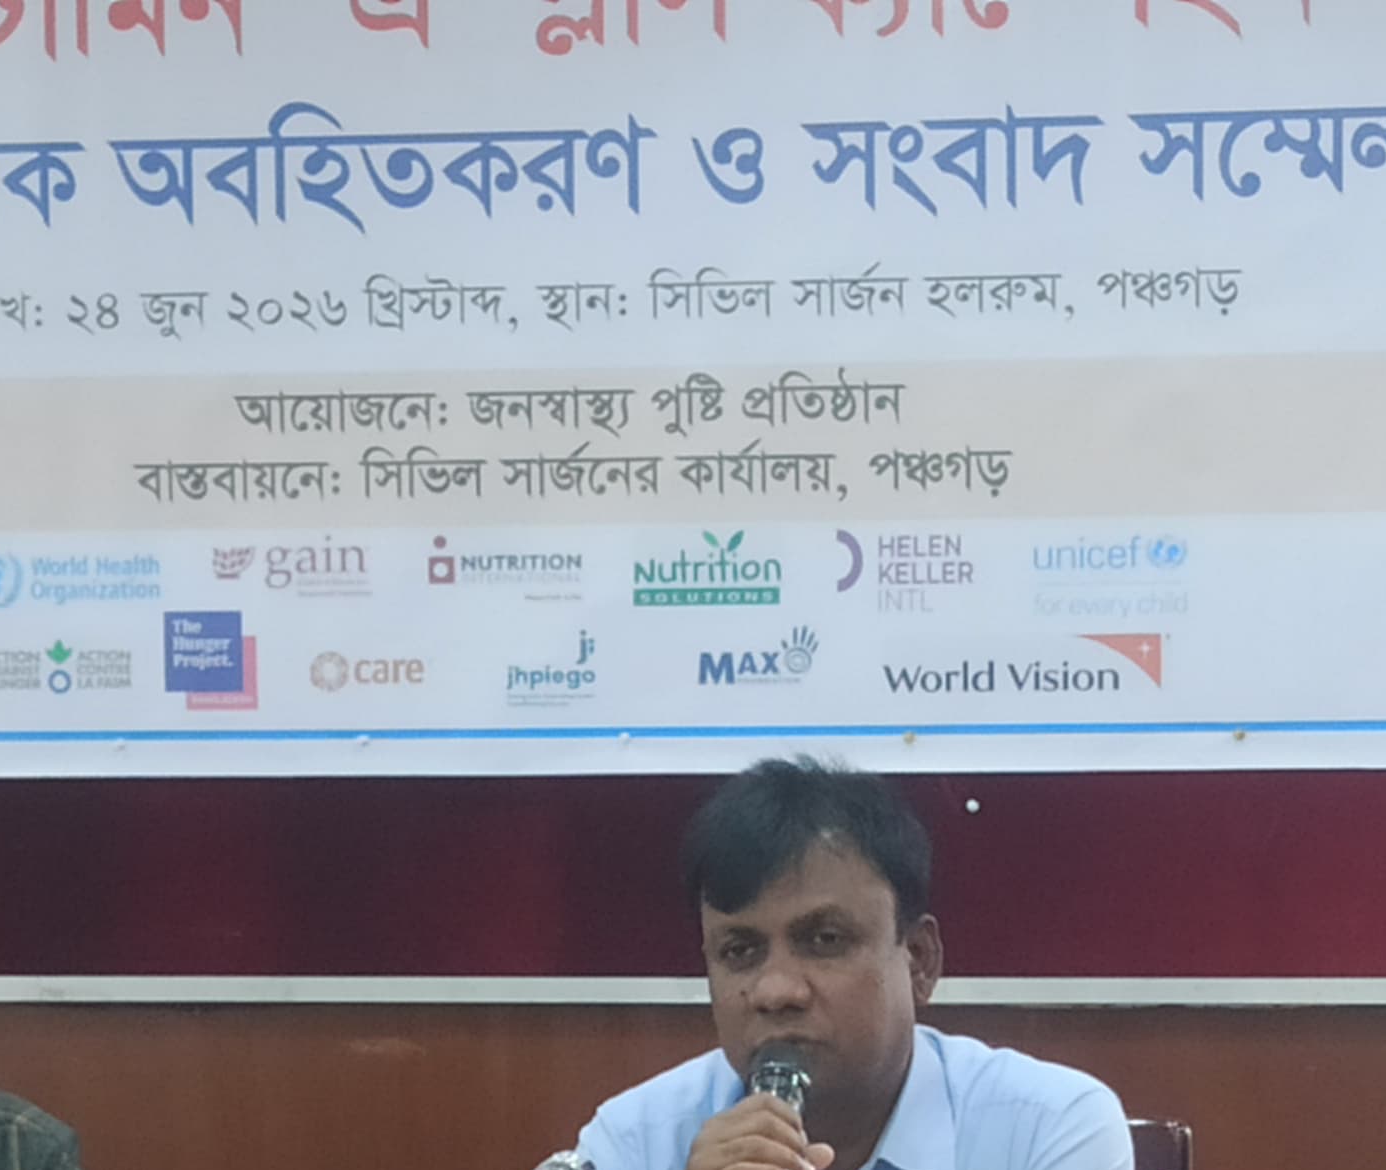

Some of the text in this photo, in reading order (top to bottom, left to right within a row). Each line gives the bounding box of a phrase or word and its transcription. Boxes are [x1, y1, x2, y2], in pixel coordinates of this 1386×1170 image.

[107, 102, 657, 235] অবহিতকরণ
[692, 128, 764, 206] ও
[801, 104, 1104, 216] সংবাদ
[67, 293, 120, 333] ২৪
[140, 292, 209, 338] জুন
[228, 291, 347, 331] ২০২৬
[536, 281, 627, 330] স্থান:
[647, 267, 776, 320] সিভিল
[791, 262, 910, 318] সার্জন
[923, 272, 1075, 318] হলরুম,
[1097, 266, 1243, 317] পঞ্চগড়
[234, 367, 907, 437] আয়োজনে: জনস্বাস্থ্য পুষ্টি প্রতিষ্ঠান
[133, 434, 1014, 502] বাস্তবায়নে: সিভিল সার্জনের কার্যালয়, পঞ্চগড়
[878, 535, 962, 558] HELEN
[1033, 536, 1141, 570] unicef
[31, 554, 160, 576] World Health
[263, 535, 366, 589] gain
[461, 554, 582, 571] NUTRITION
[634, 549, 782, 583] Nutrition
[878, 561, 974, 584] KELLER
[31, 579, 160, 604] Organization
[638, 590, 774, 604] SOLUTIONS
[878, 589, 934, 613] INTL
[171, 618, 201, 634] The
[173, 636, 231, 653] Hunger
[173, 653, 234, 671] Project.
[354, 657, 425, 684] care
[698, 651, 780, 685] MAX
[506, 665, 596, 690] jhpiego
[883, 660, 1120, 694] World Vision
